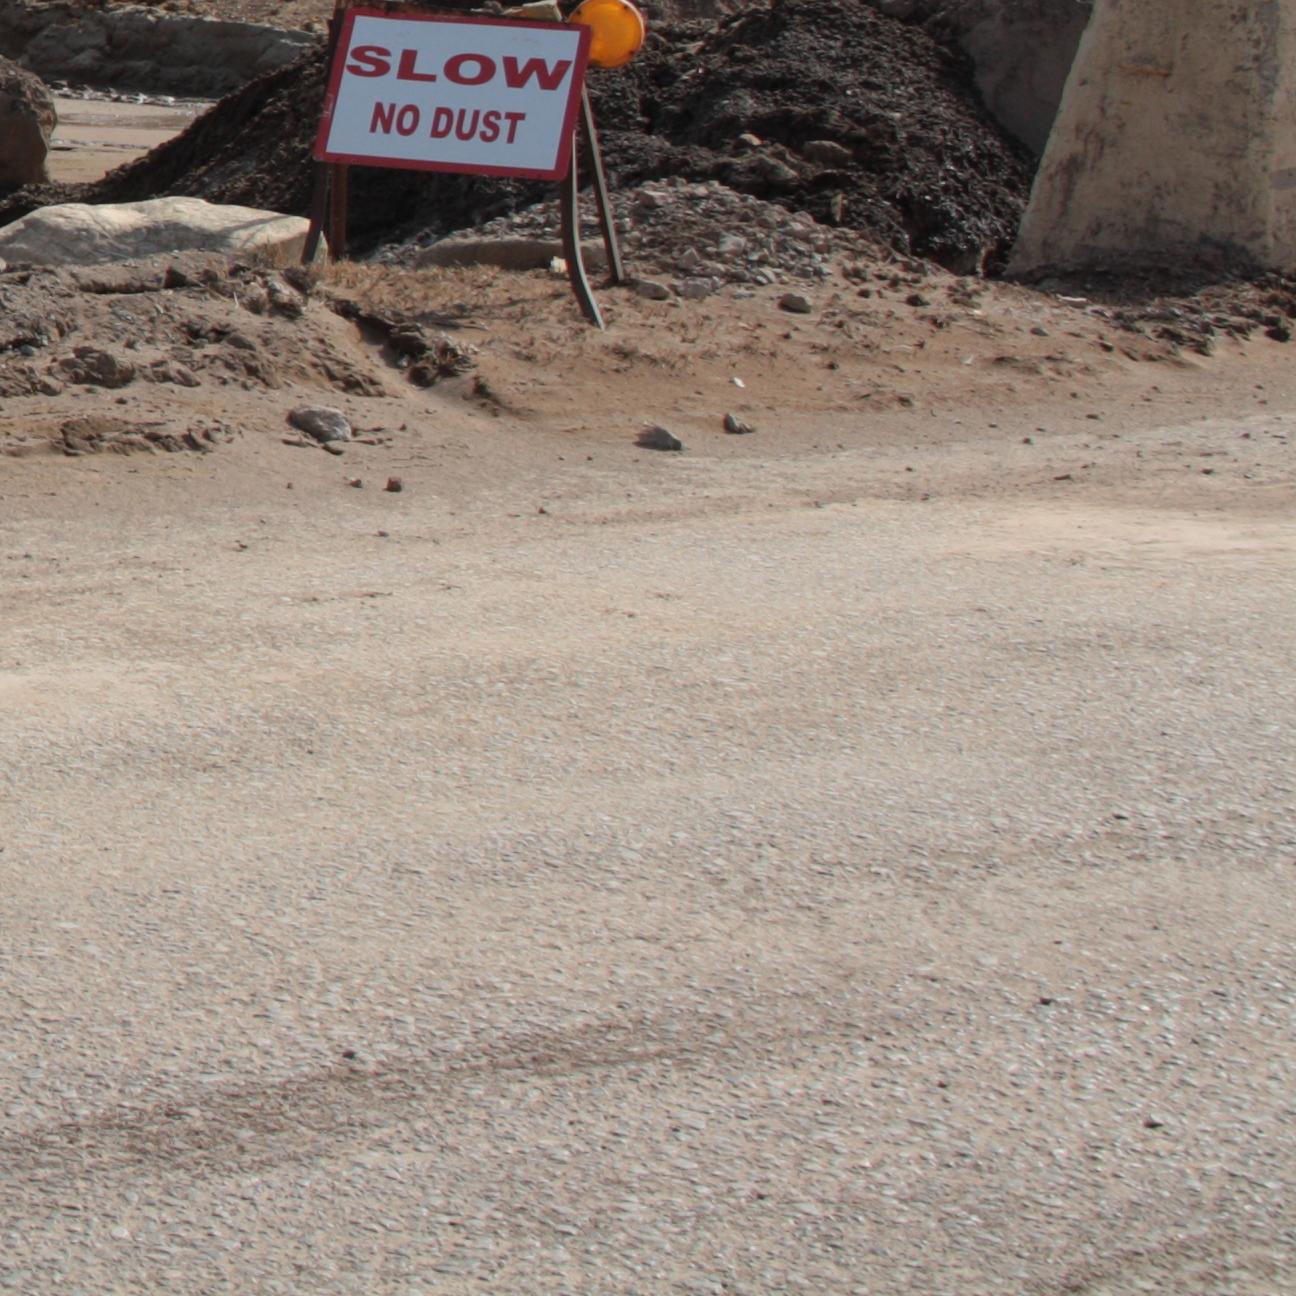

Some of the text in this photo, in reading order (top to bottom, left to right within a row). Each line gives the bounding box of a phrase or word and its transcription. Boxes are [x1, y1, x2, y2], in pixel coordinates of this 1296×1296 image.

[345, 45, 572, 91] SLOW
[369, 101, 526, 144] NO DUST
